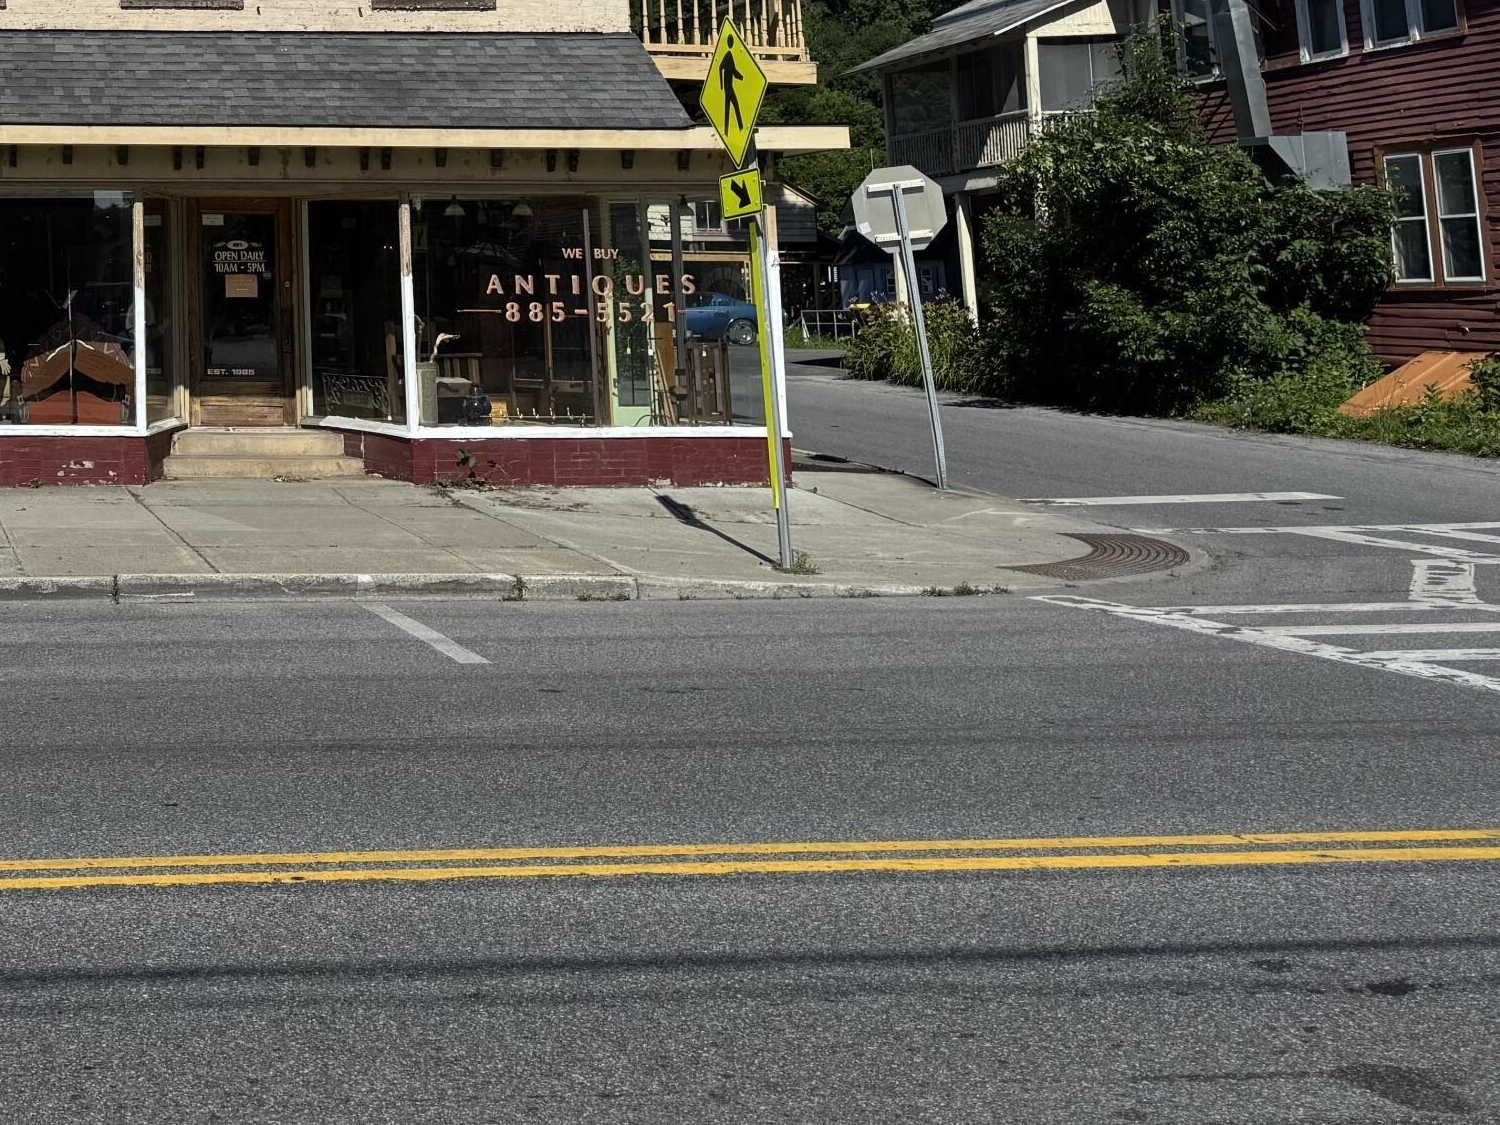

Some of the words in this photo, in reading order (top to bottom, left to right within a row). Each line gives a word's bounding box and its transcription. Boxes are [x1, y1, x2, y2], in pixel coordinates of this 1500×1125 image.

[214, 251, 238, 261] OPEN
[240, 251, 265, 261] DAILY
[562, 248, 583, 259] WE
[594, 248, 619, 260] BUY
[214, 263, 238, 273] 10AM
[247, 263, 265, 273] 5PM
[486, 274, 696, 298] ANTIQUES
[505, 302, 676, 322] 885-5521
